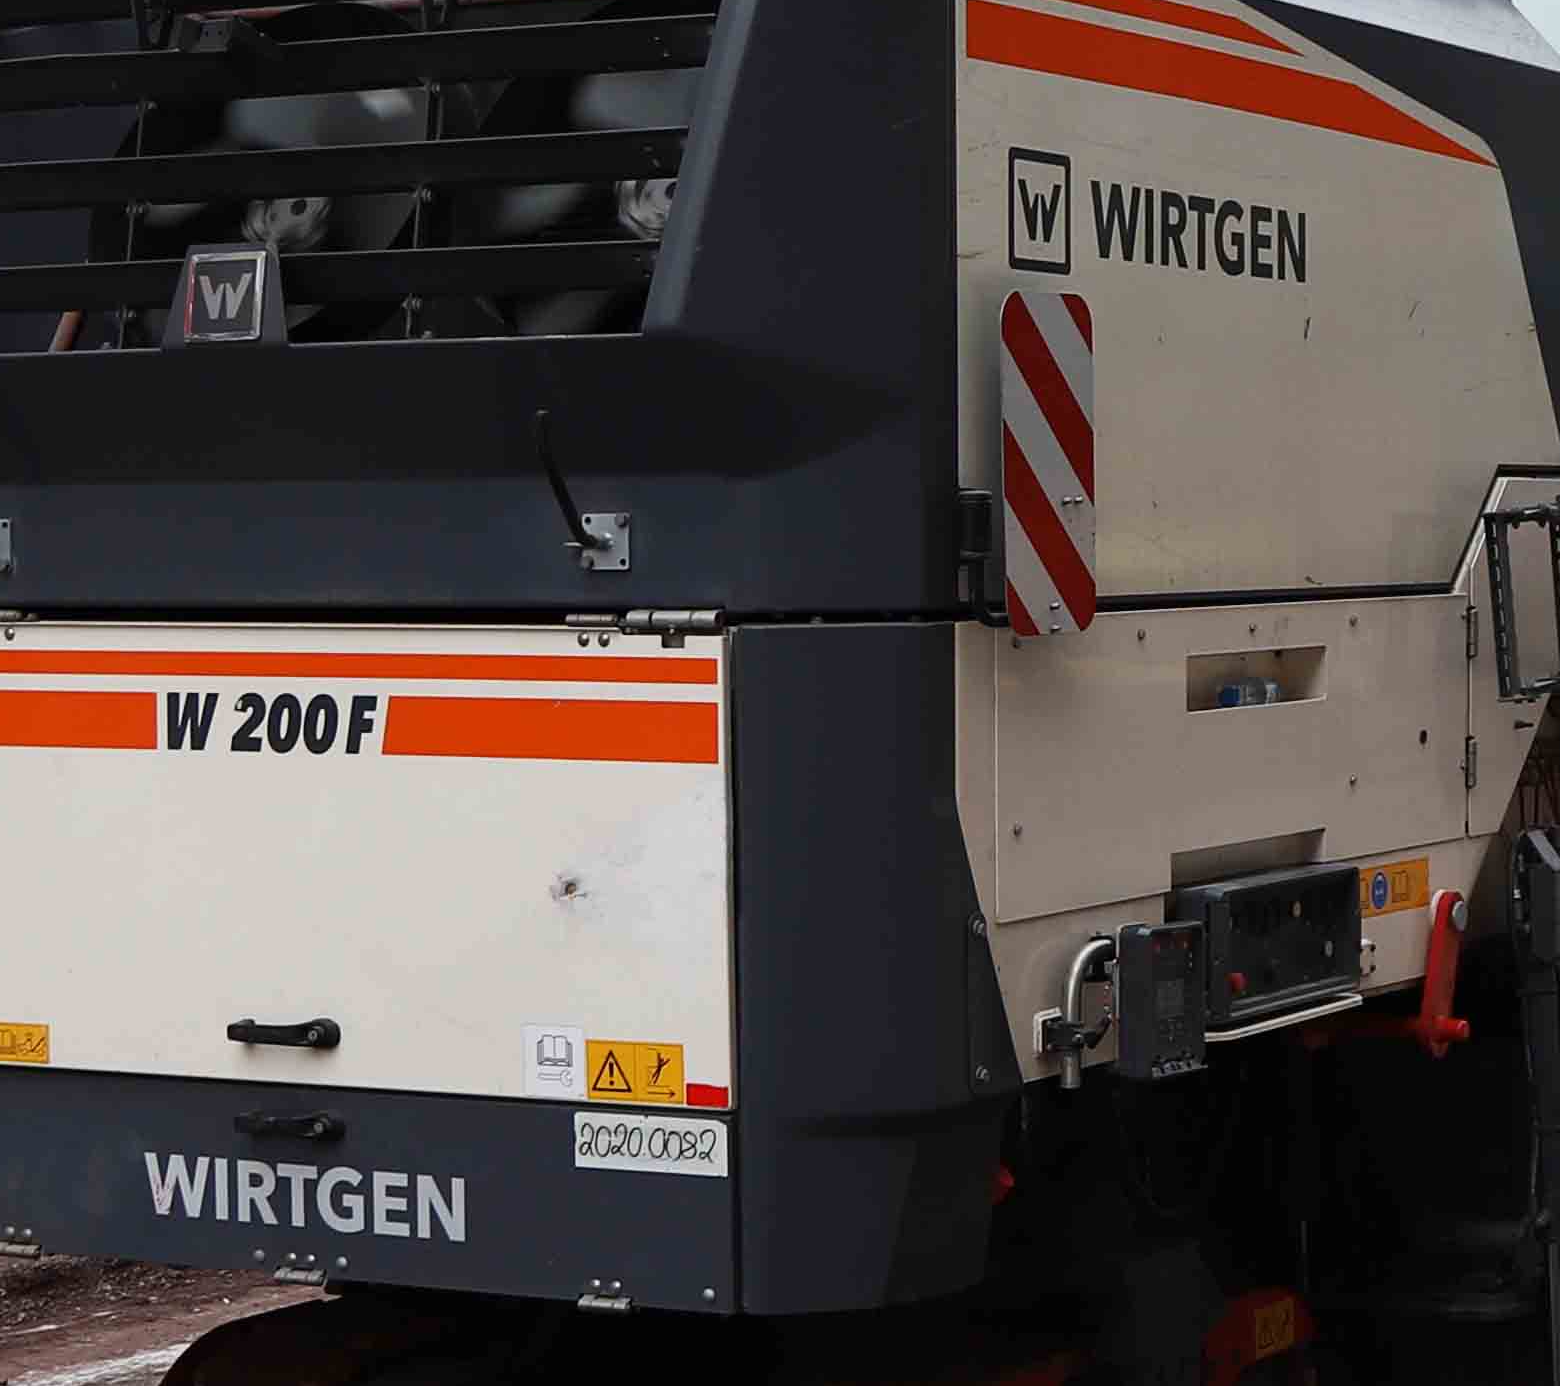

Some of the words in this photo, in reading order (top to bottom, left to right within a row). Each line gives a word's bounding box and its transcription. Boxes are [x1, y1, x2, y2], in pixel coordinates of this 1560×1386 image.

[1090, 179, 1306, 284] WIRTGEN
[167, 692, 219, 750] W
[144, 1151, 466, 1242] WIRTGEN
